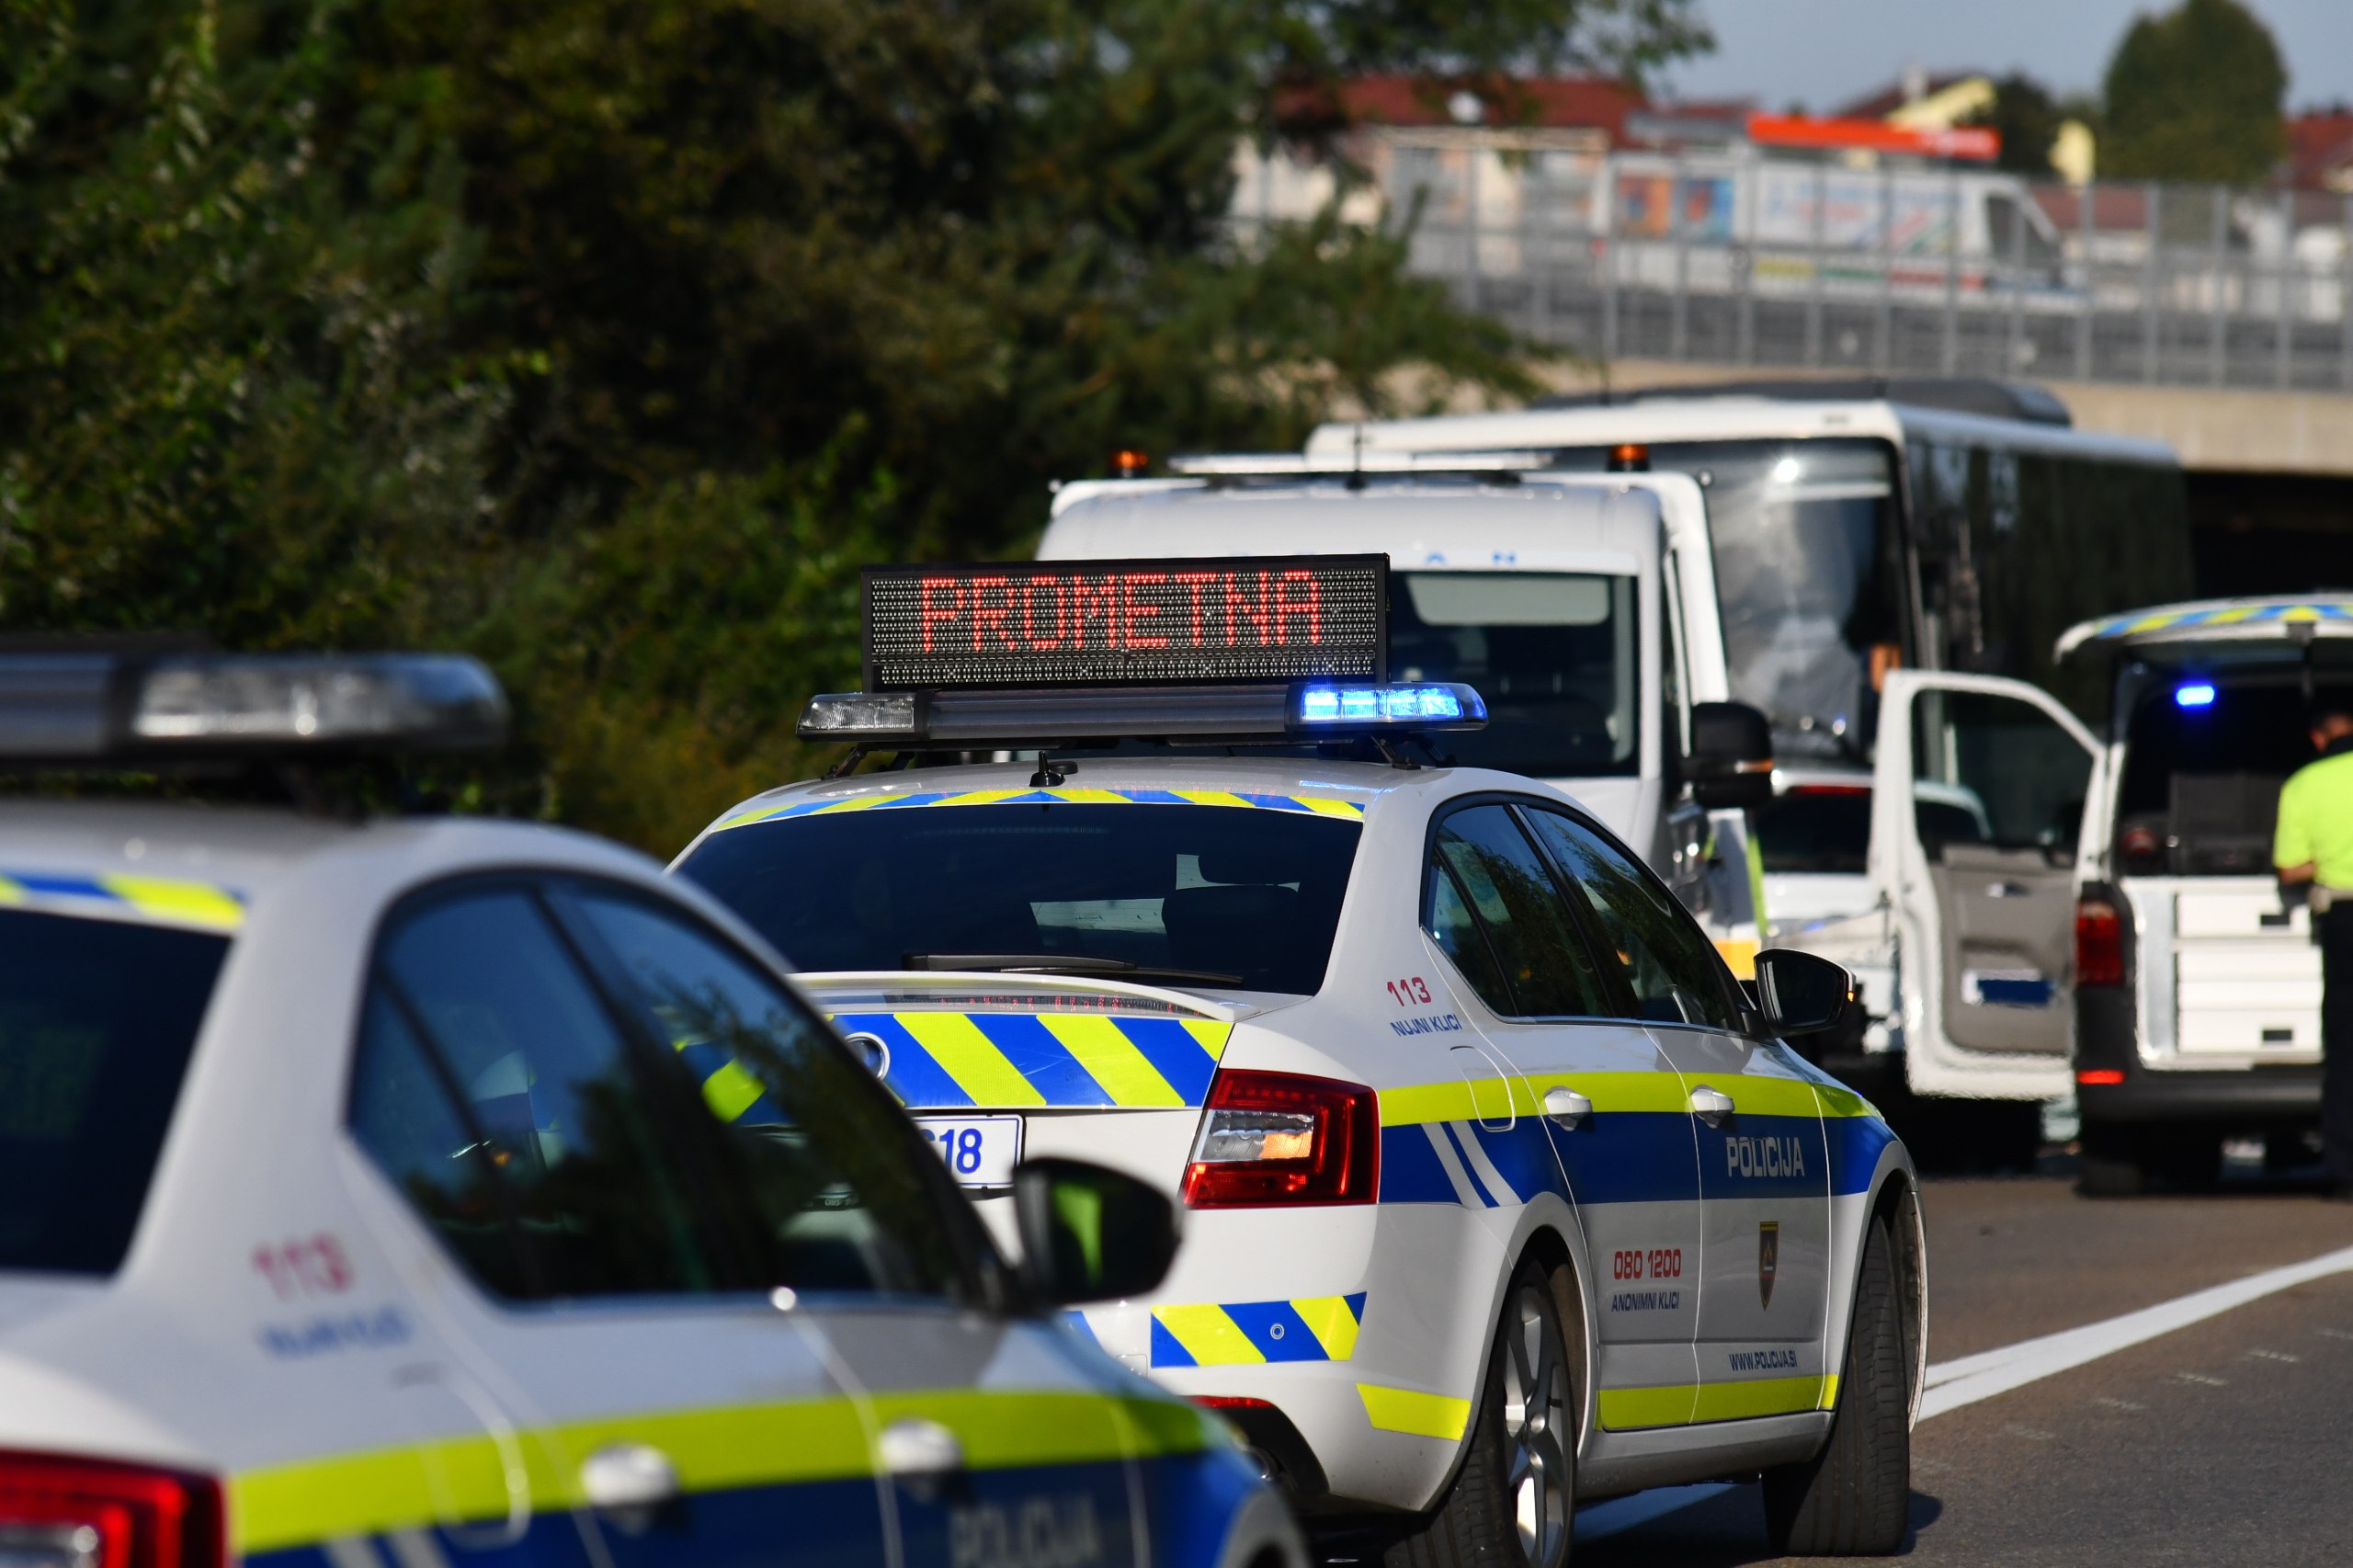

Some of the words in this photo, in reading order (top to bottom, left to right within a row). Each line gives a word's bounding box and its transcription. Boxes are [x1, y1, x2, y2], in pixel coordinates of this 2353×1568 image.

[920, 570, 1322, 653] PROMETNA
[1386, 976, 1432, 1007] 113
[1390, 1017, 1433, 1037] NUJNI
[1428, 1014, 1463, 1032] KLICI
[1725, 1136, 1805, 1177] POLICIJA
[1613, 1250, 1643, 1280] 080
[1647, 1248, 1682, 1278] 1200
[1611, 1292, 1657, 1312] ANONIMNI
[1657, 1290, 1680, 1310] KLICI
[1729, 1349, 1798, 1372] WWW.POLICIJA.SI
